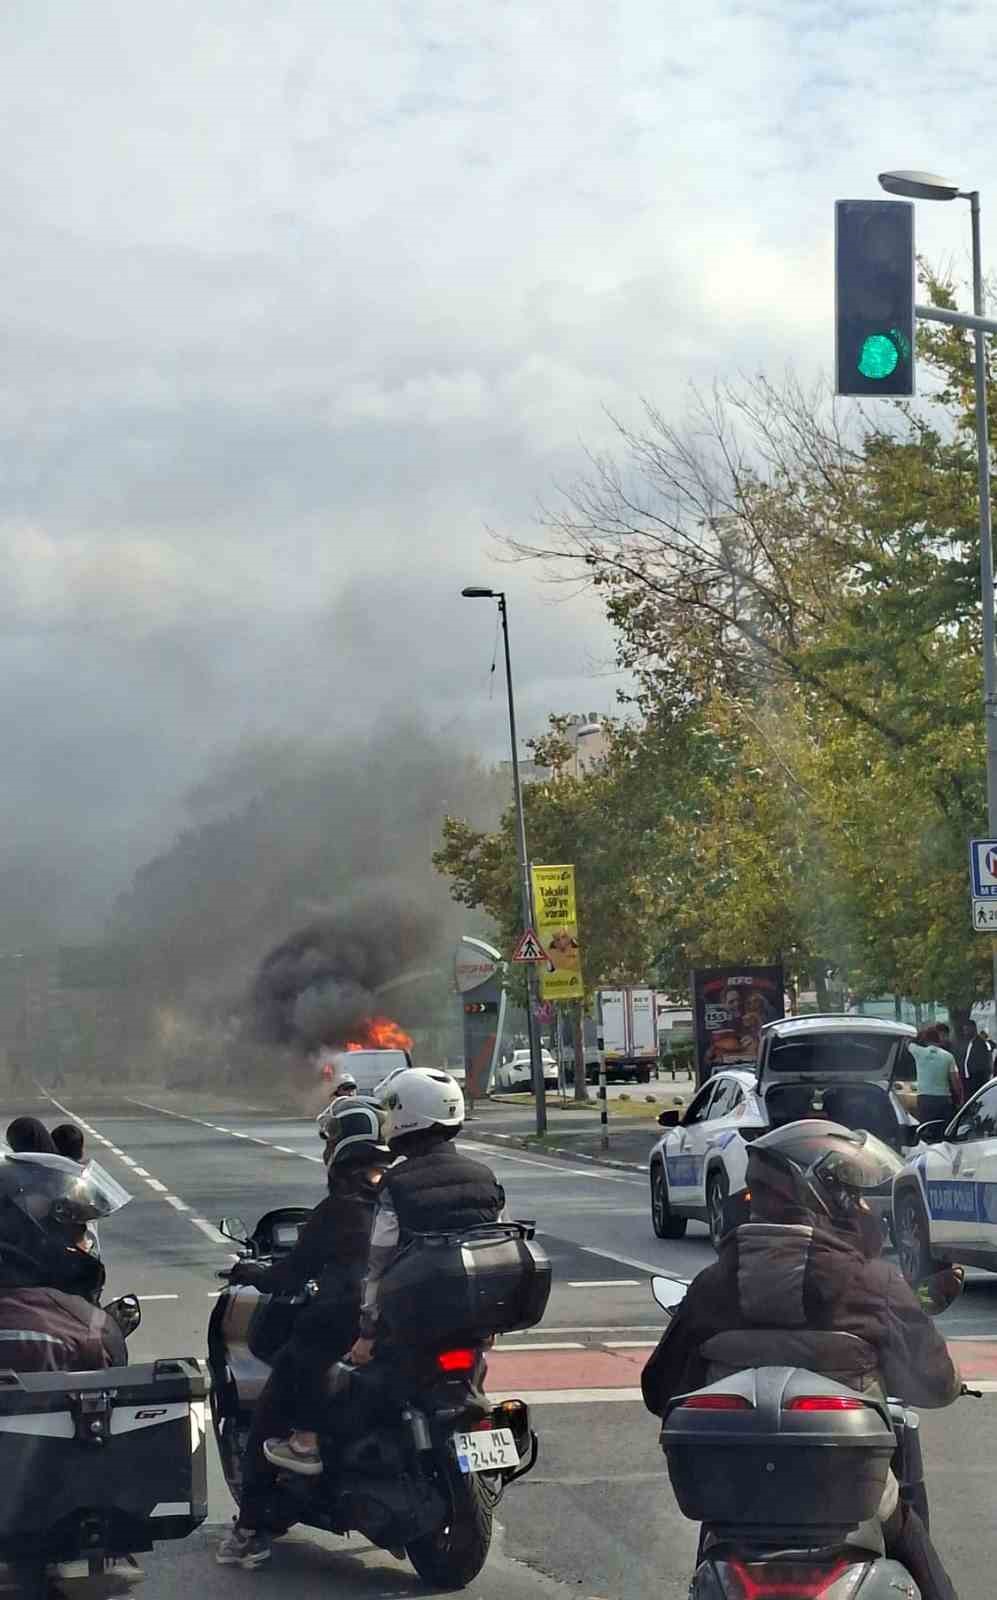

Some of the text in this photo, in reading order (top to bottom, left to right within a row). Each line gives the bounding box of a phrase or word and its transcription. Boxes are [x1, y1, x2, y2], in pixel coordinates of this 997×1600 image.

[727, 976, 752, 985] KFC
[460, 1434, 476, 1450] 34
[472, 1449, 508, 1468] 2442
